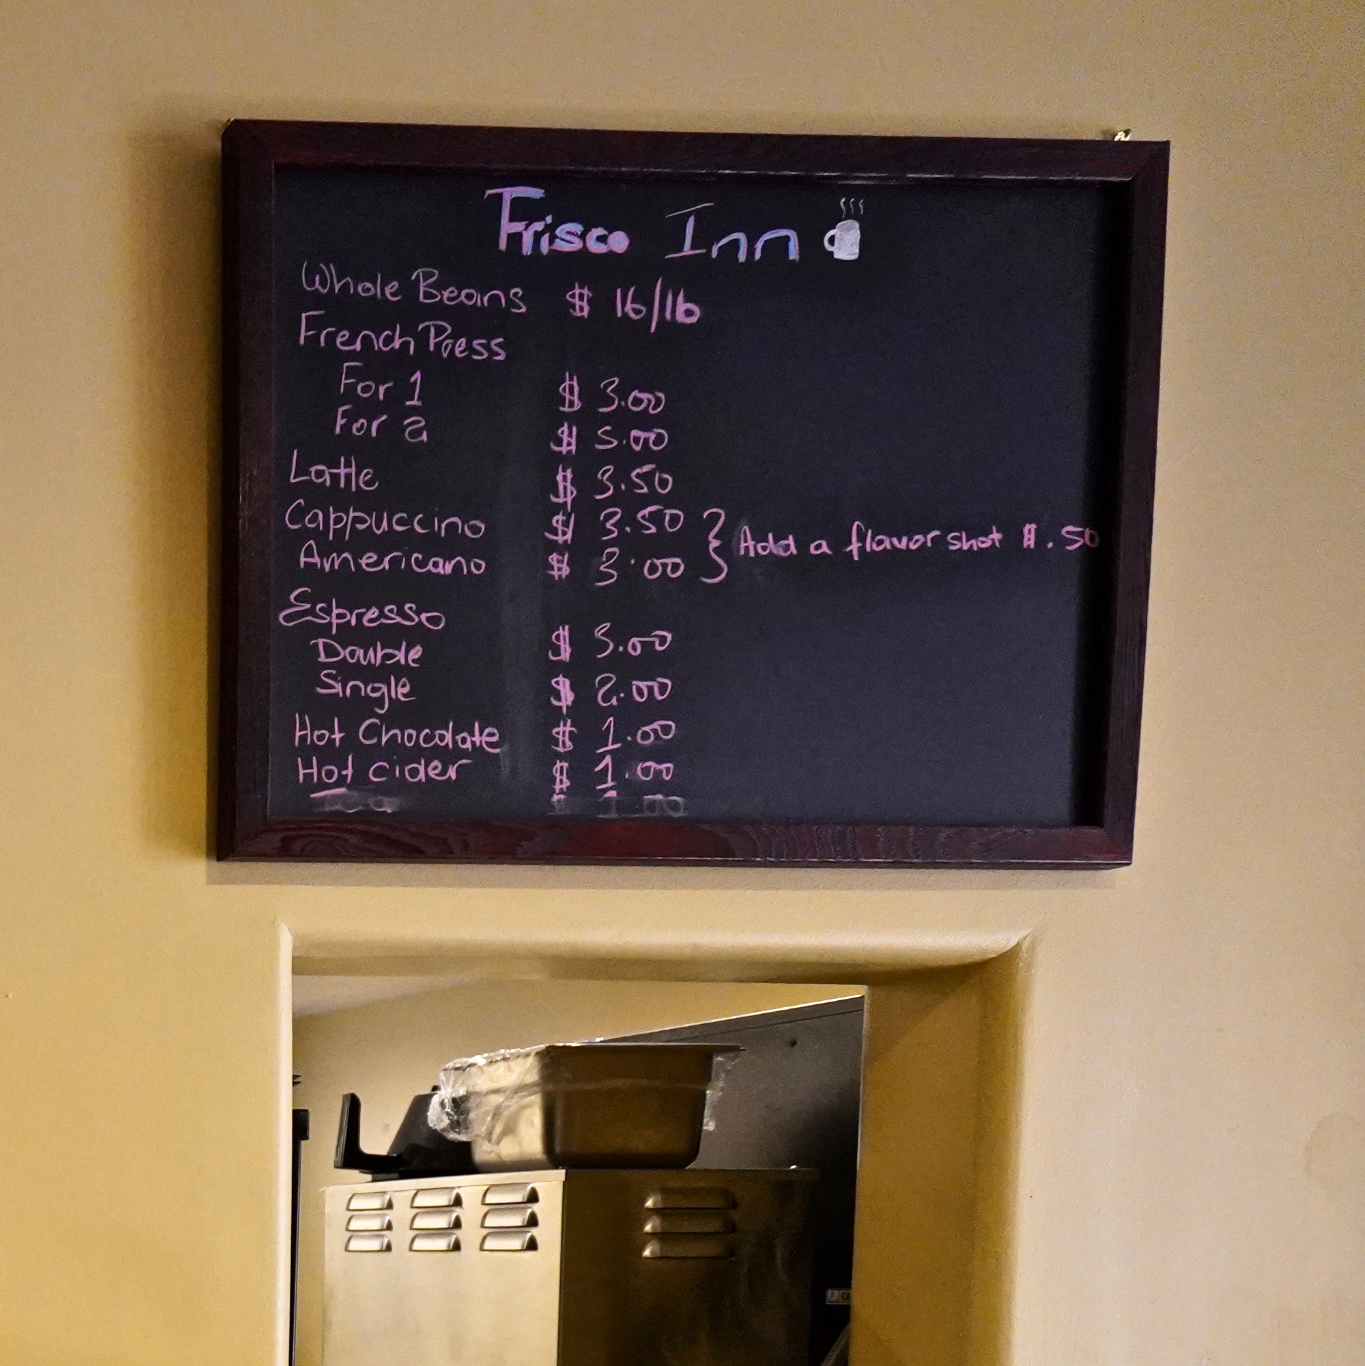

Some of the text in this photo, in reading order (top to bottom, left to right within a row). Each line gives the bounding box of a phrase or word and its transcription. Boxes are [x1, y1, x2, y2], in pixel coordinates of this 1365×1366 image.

[484, 185, 800, 263] Frisco Inn
[301, 262, 401, 302] Whole
[411, 268, 527, 313] Beans
[299, 310, 506, 361] French Press
[340, 361, 393, 401] For
[405, 370, 422, 406] 1
[335, 404, 388, 438] For
[289, 449, 379, 492] Latte
[284, 498, 486, 541] Cappuccino
[738, 524, 798, 558] Add
[809, 539, 833, 556] a
[844, 520, 942, 561] flavor
[946, 525, 1003, 552] shot
[299, 539, 487, 576] Americano
[277, 586, 446, 635] Espresso
[309, 637, 423, 668] Double
[315, 669, 416, 715] Single
[294, 712, 345, 748] Hot
[358, 717, 505, 754] Chocolate
[297, 753, 354, 784] Hot
[368, 757, 473, 783] cider
